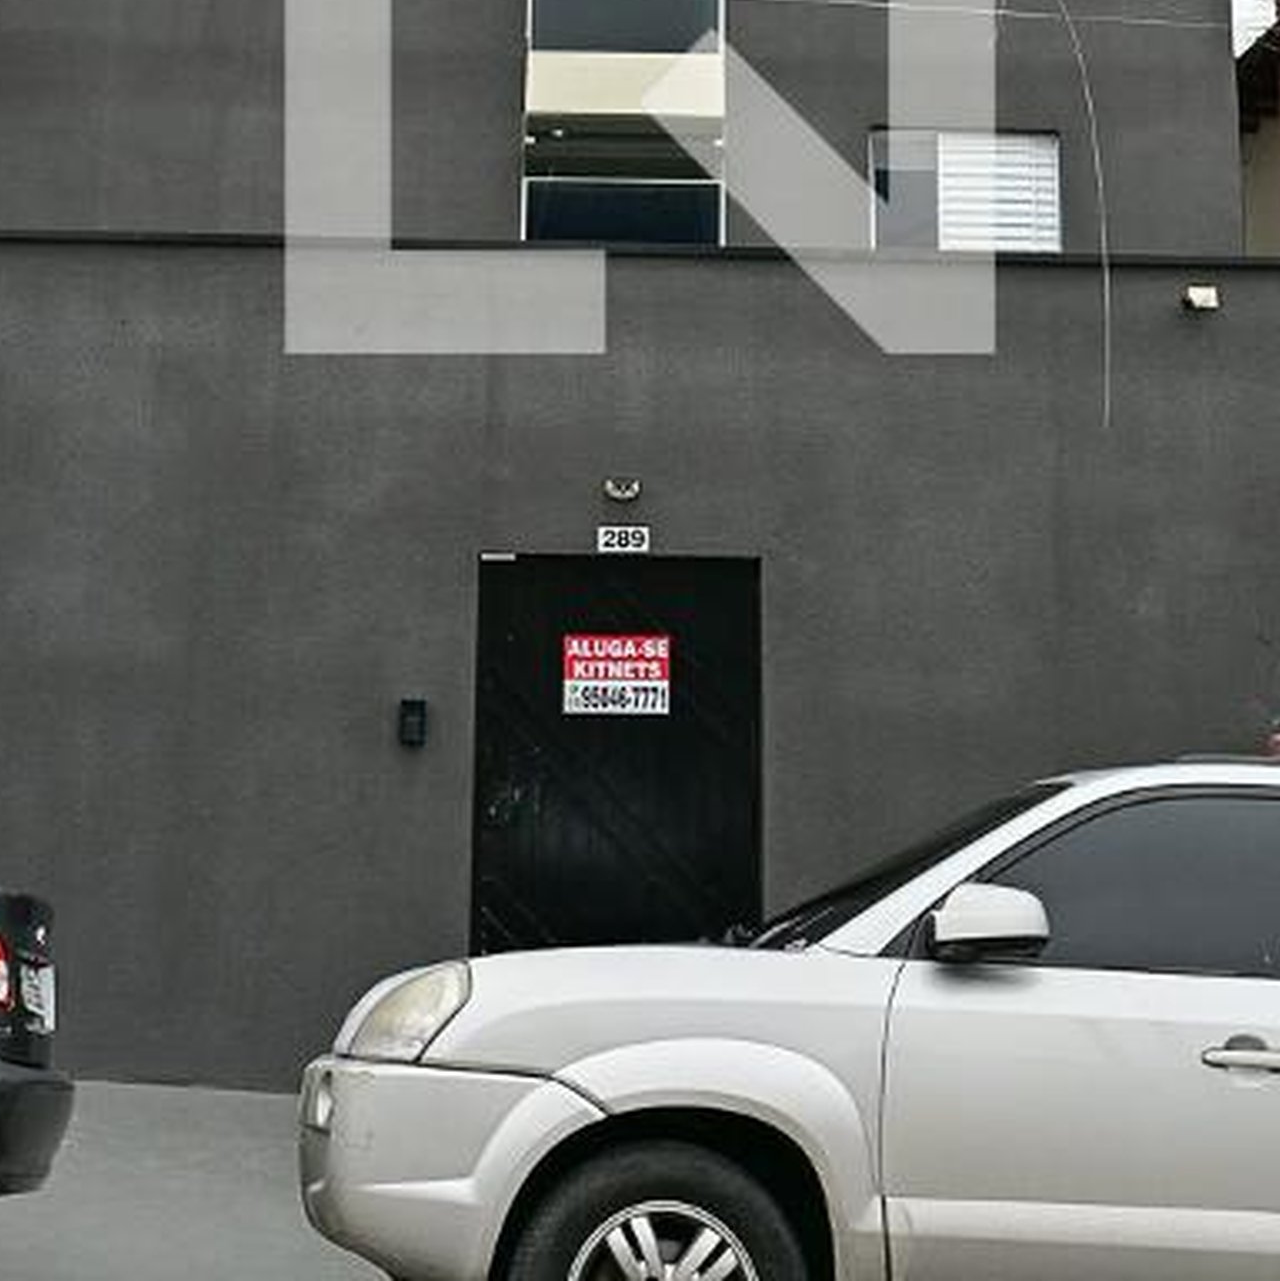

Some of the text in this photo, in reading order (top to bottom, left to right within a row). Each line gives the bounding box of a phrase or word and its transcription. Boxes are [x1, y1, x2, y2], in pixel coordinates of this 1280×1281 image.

[602, 528, 646, 549] 289
[567, 638, 668, 658] ALUGA-SE
[573, 659, 662, 679] KITNETS
